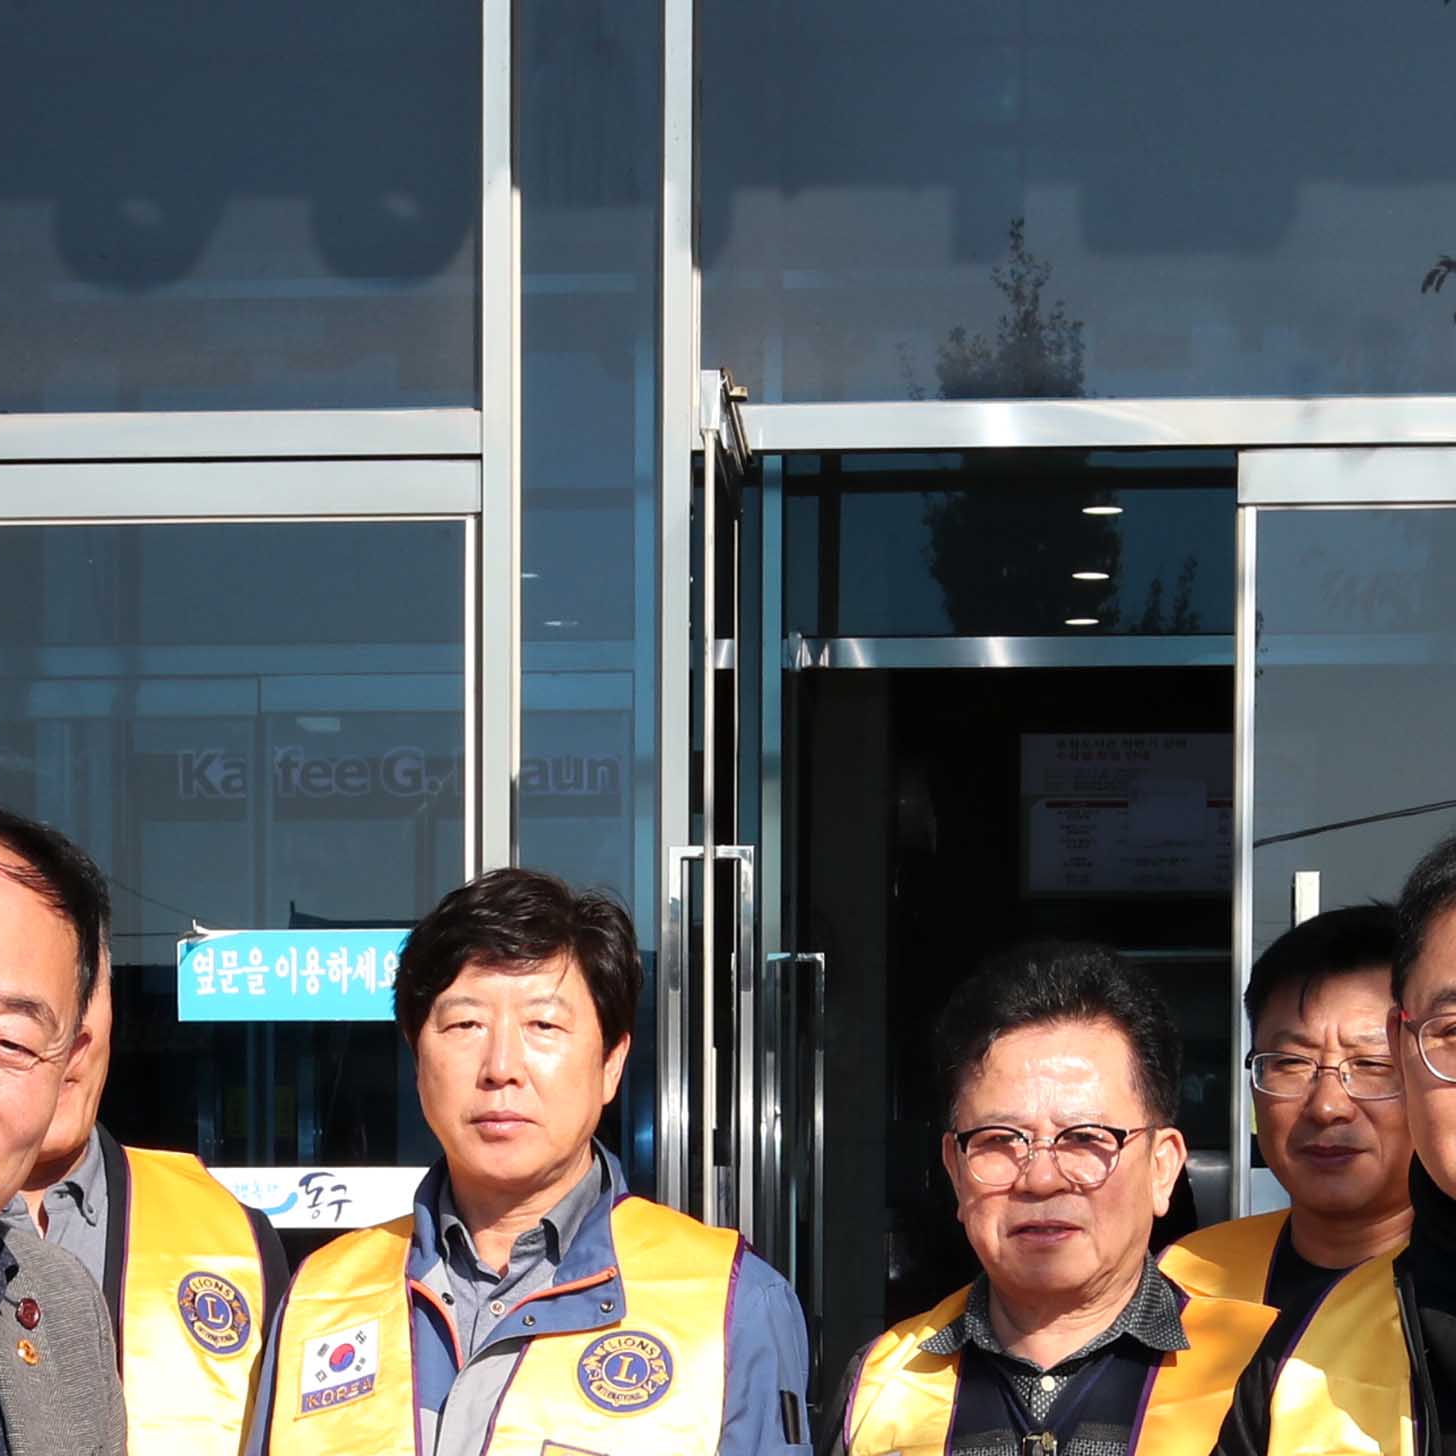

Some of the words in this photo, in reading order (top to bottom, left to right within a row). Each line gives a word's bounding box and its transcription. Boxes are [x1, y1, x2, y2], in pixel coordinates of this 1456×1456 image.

[177, 746, 372, 800] Kafee
[192, 946, 271, 996] 옆문을
[274, 946, 401, 996] 이용하세요
[298, 1171, 353, 1223] 동구
[191, 1278, 232, 1298] LIONS
[204, 1296, 225, 1324] L
[607, 1337, 657, 1357] LIONS
[613, 1355, 638, 1385] L
[305, 1376, 373, 1409] KOREA
